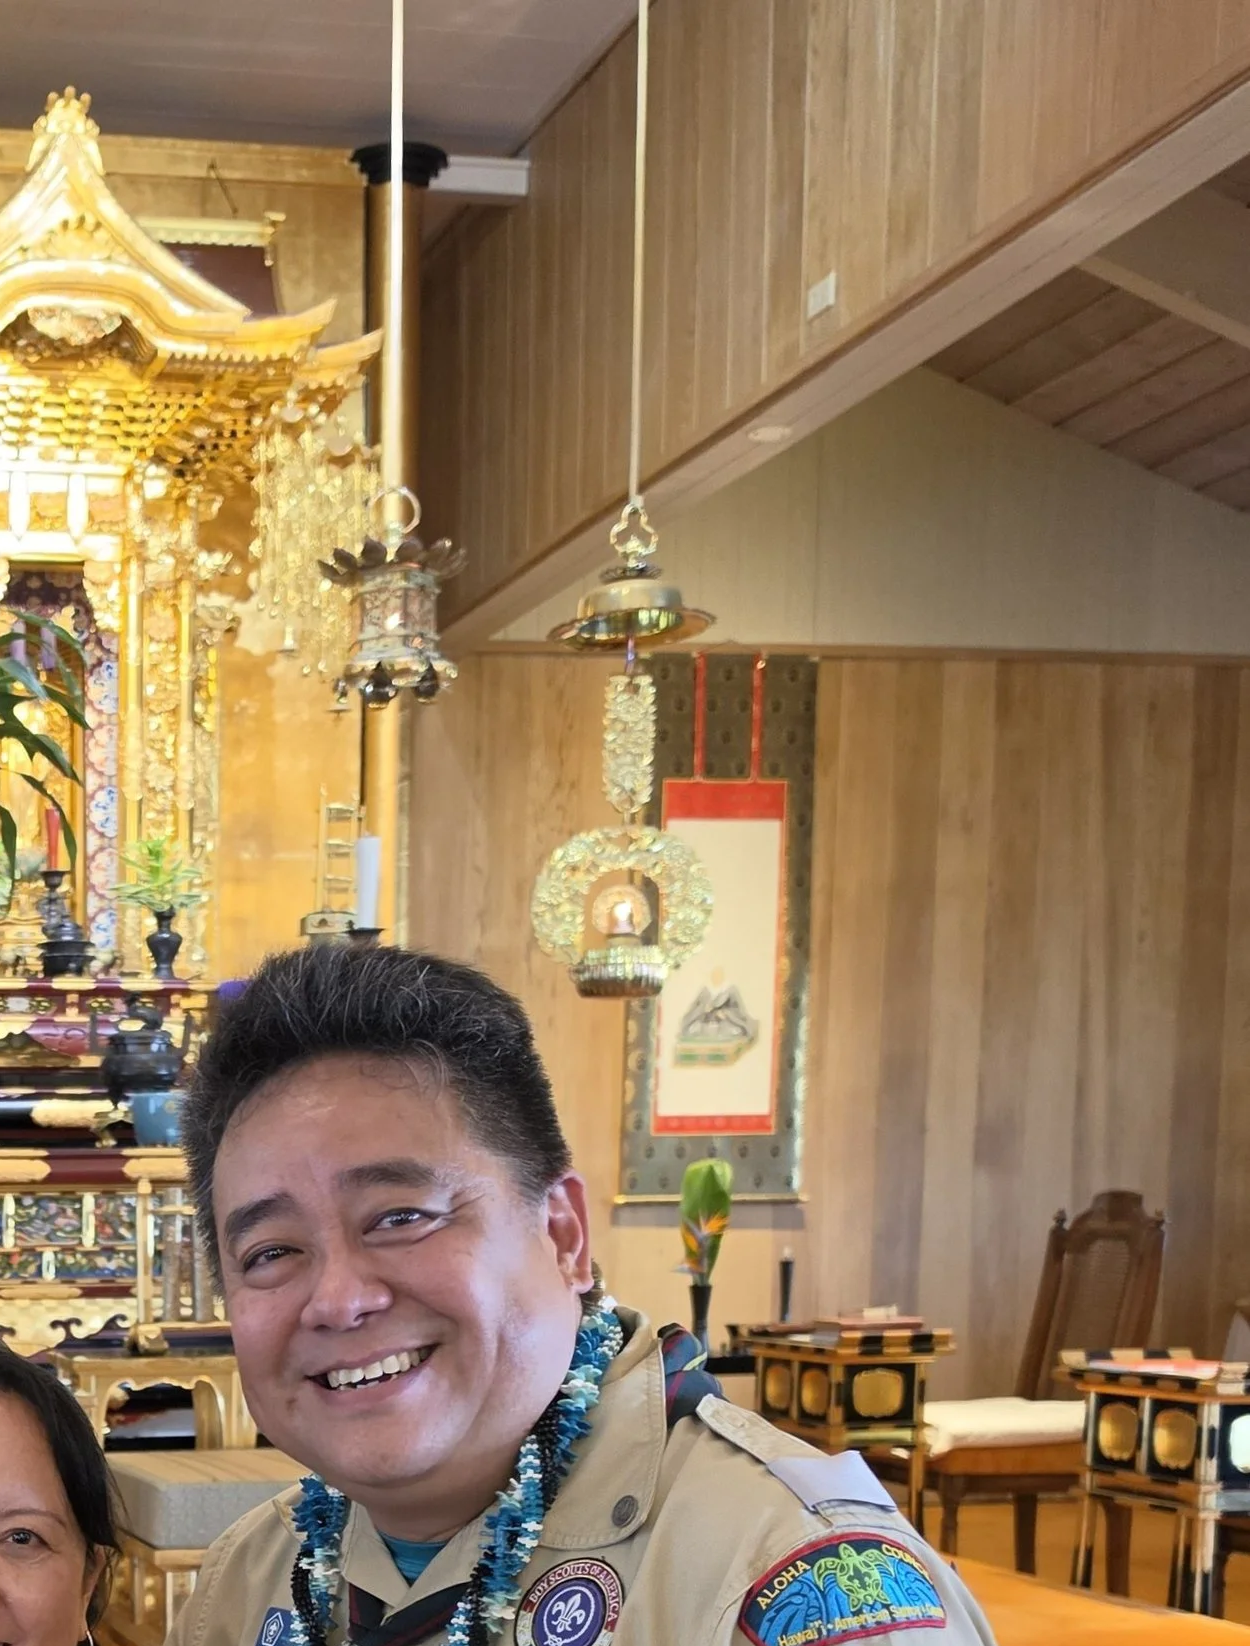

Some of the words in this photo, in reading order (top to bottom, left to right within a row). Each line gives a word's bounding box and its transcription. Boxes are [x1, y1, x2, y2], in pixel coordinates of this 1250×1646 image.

[529, 1580, 548, 1603] BOY
[550, 1564, 591, 1583] SCOUTS
[597, 1570, 619, 1621] AMERICA
[756, 1560, 811, 1610] ALOHA
[881, 1543, 934, 1585] COUNC
[834, 1608, 890, 1631] American
